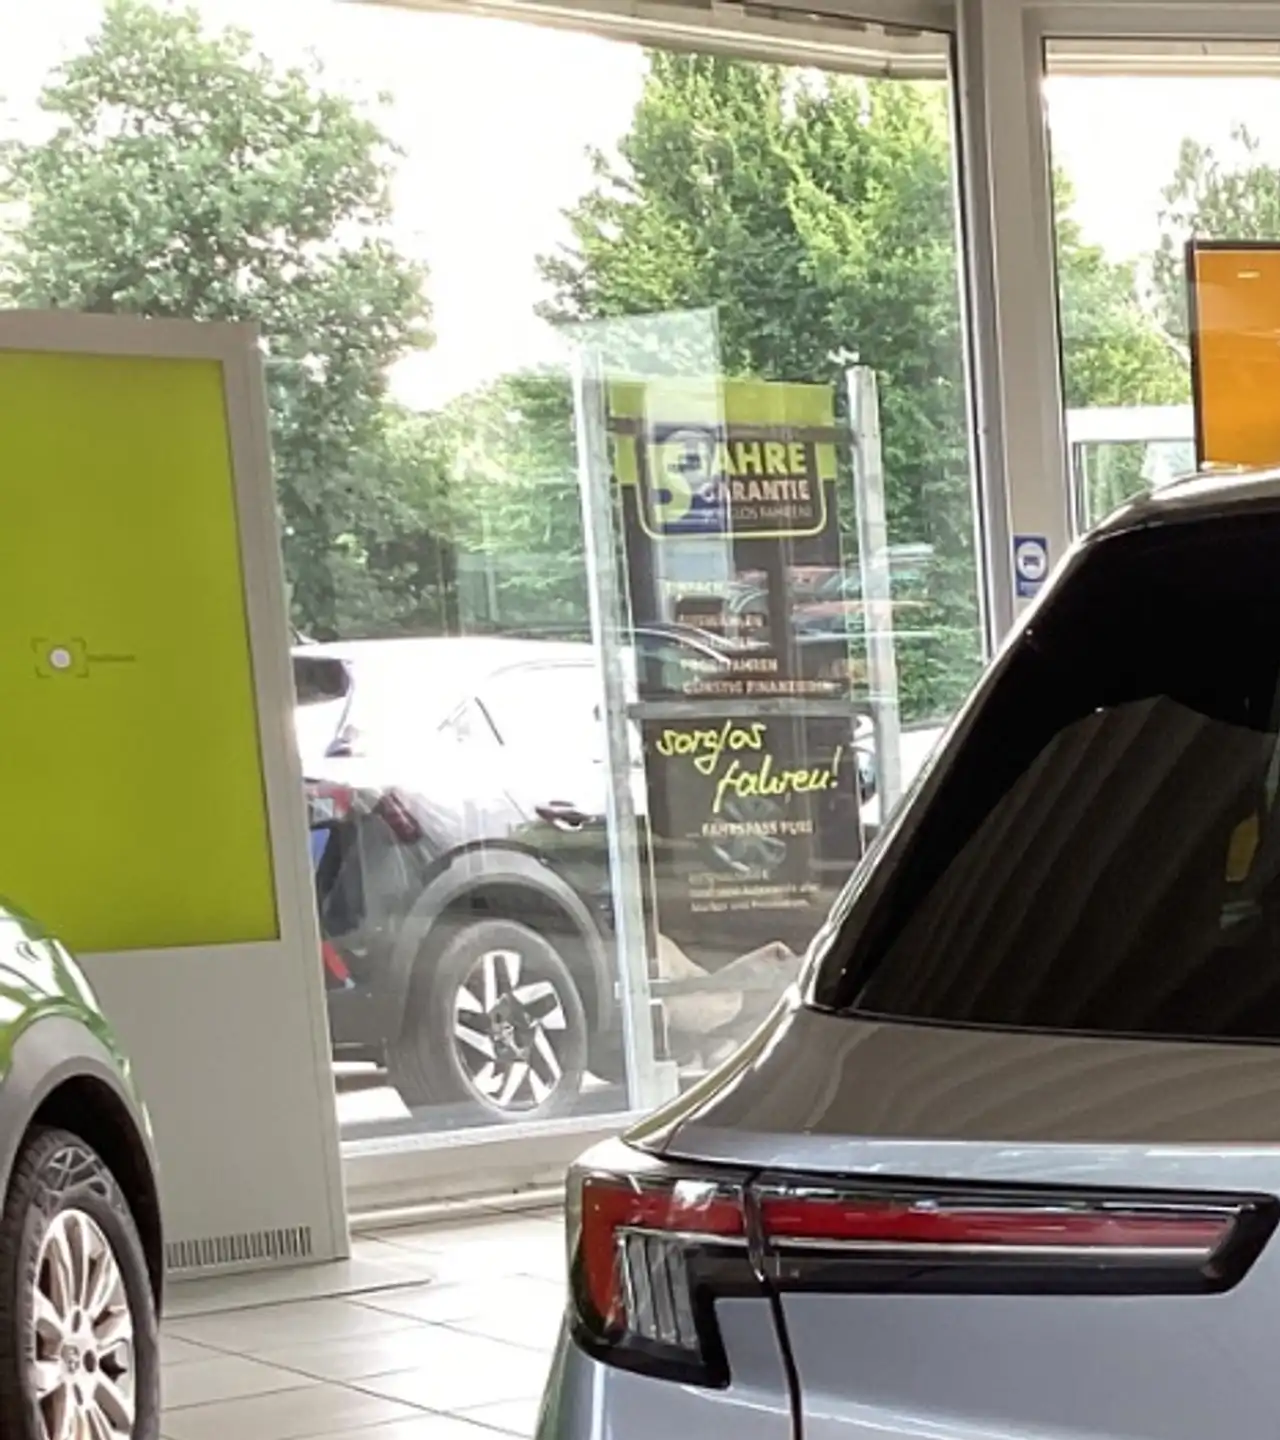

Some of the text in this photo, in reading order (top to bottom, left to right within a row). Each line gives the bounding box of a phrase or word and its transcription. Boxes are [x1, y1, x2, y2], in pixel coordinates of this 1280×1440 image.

[697, 440, 807, 477] JAHRE
[701, 479, 811, 502] GARANTIE
[712, 745, 843, 813] fahren!
